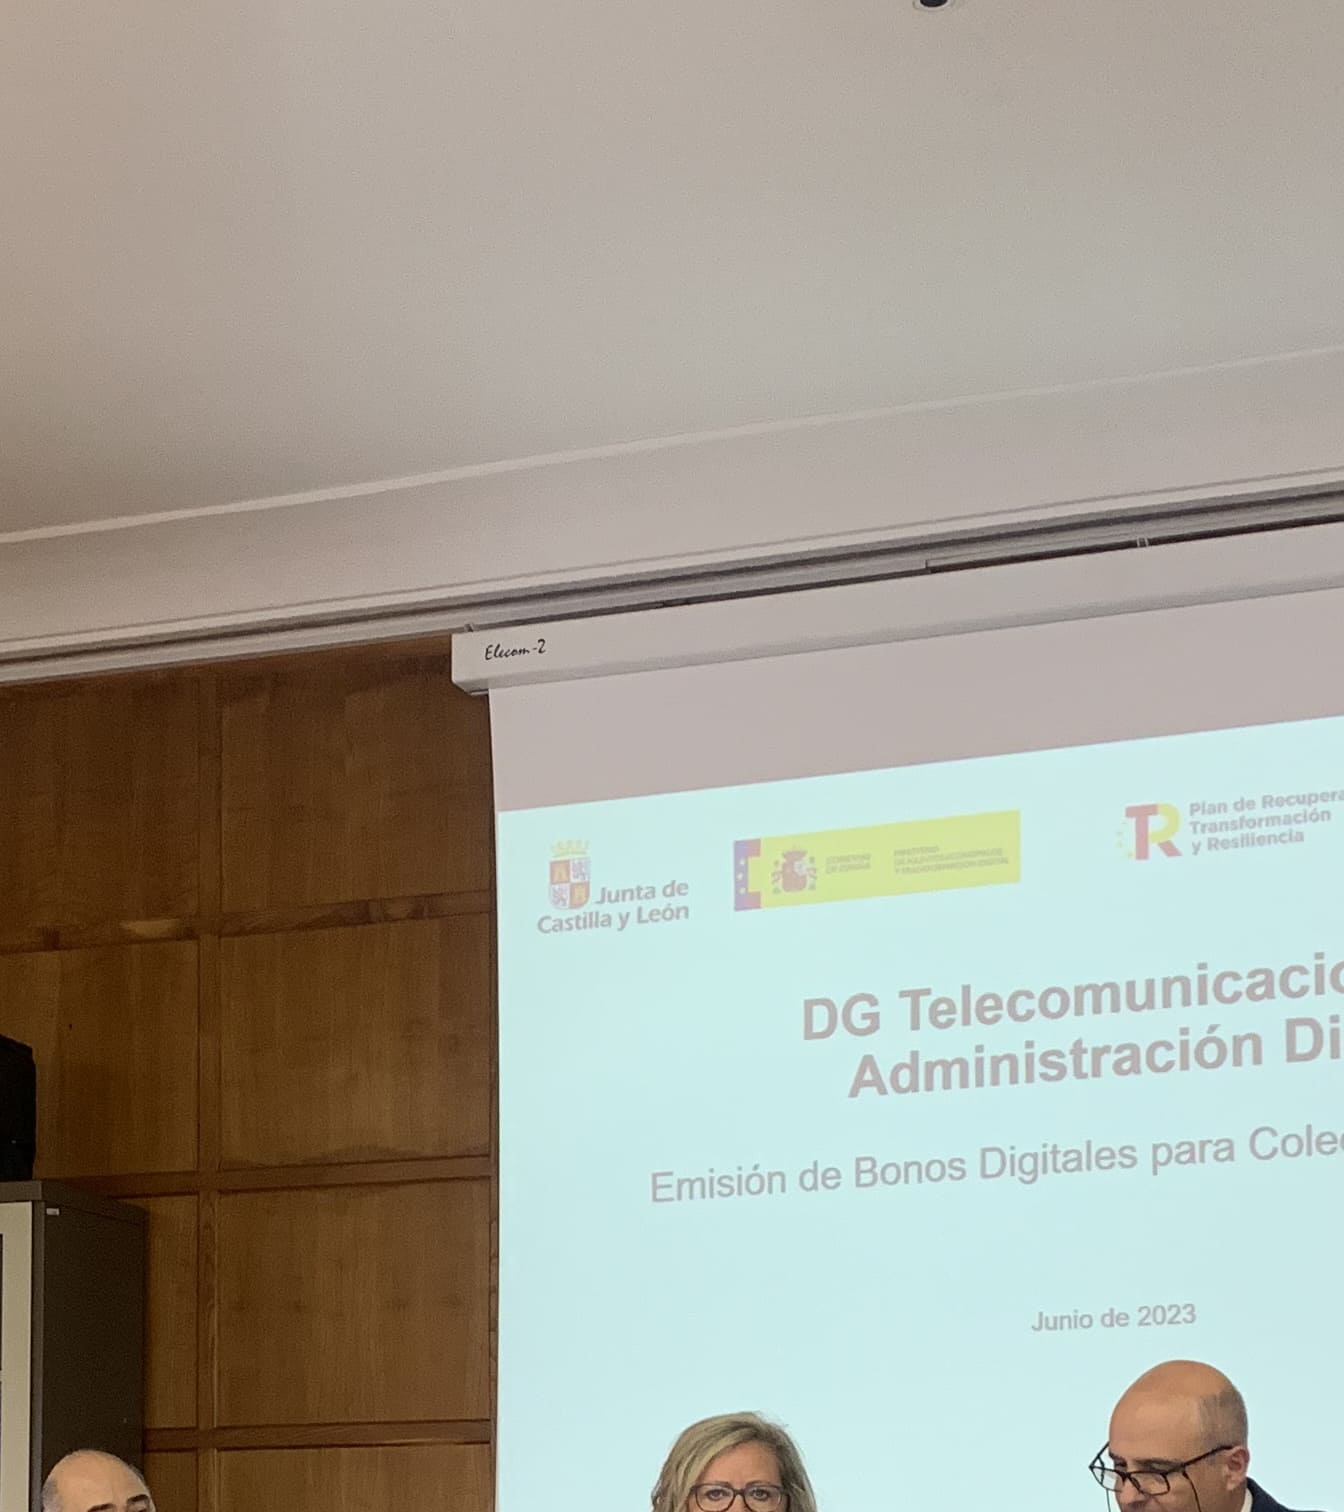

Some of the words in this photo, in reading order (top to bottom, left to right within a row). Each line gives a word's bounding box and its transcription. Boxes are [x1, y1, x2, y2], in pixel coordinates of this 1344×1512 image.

[1190, 801, 1228, 816] Plan
[1233, 797, 1256, 812] de
[1189, 808, 1331, 834] Transformación
[1192, 841, 1201, 856] y
[1207, 829, 1304, 851] Resiliencia
[595, 885, 656, 904] Junta
[662, 880, 689, 898] de
[537, 911, 612, 934] Castilla
[617, 912, 630, 931] y
[637, 903, 689, 924] León
[804, 993, 880, 1040] DG
[848, 1024, 1262, 1098] Administración
[652, 1164, 786, 1202] Emisión
[798, 1160, 842, 1192] de
[855, 1156, 966, 1188] Bonos
[980, 1140, 1138, 1184] Digitales
[1152, 1138, 1235, 1176] para
[1032, 1309, 1093, 1331] Junio
[1100, 1308, 1130, 1328] de
[1137, 1304, 1196, 1326] 2023
